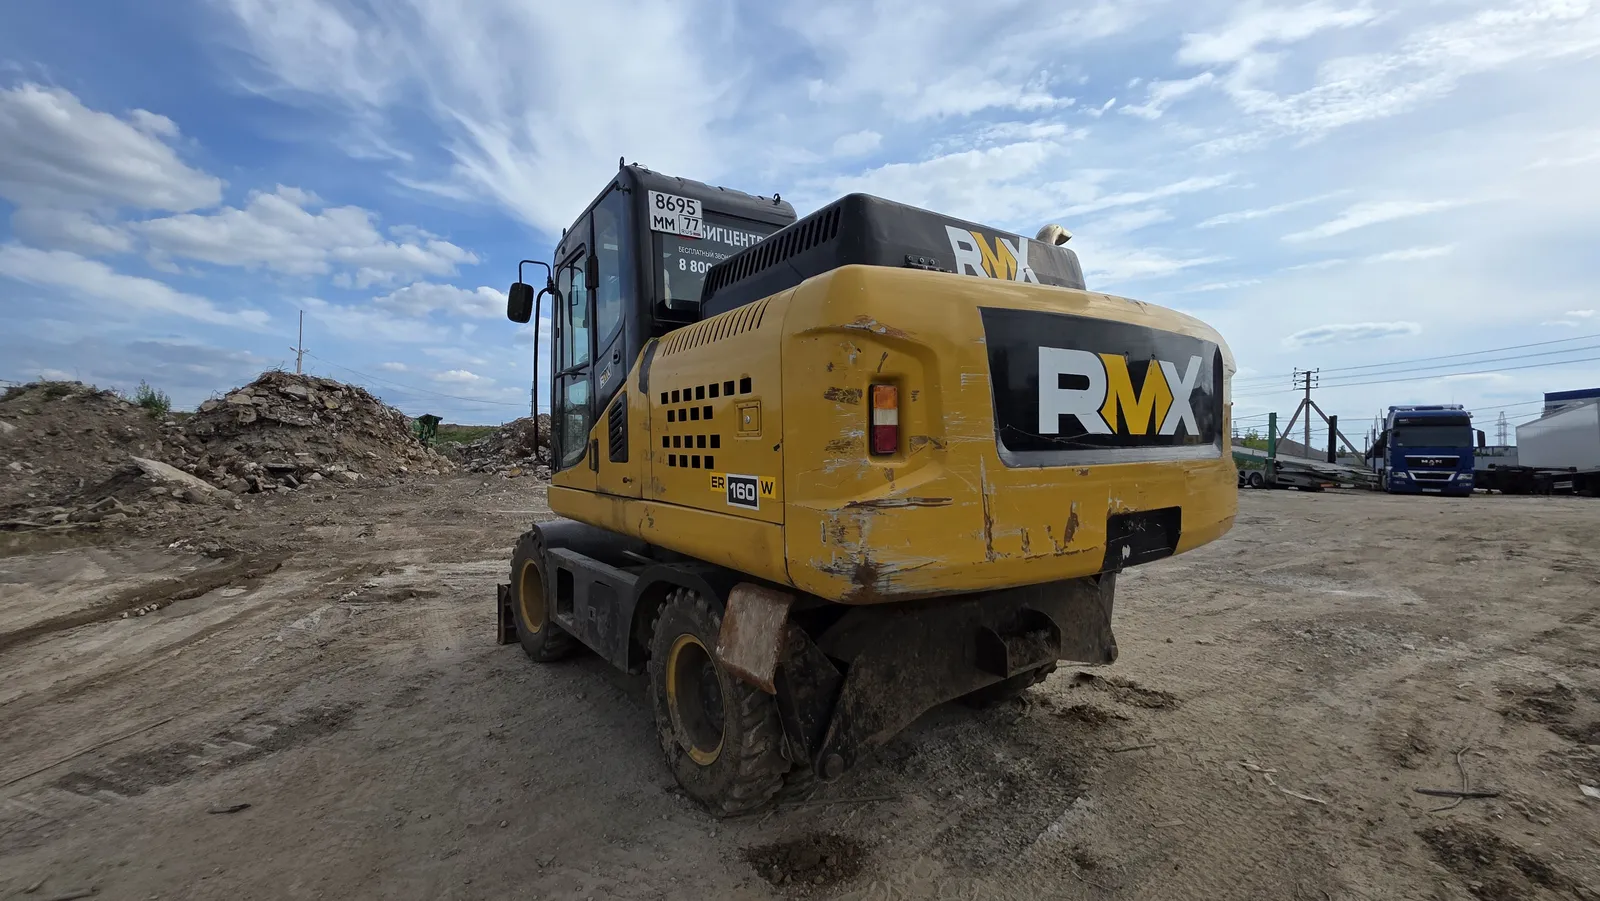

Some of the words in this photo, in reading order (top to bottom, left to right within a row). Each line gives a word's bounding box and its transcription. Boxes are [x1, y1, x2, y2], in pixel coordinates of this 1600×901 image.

[656, 194, 695, 215] 8695
[654, 215, 675, 230] ММ
[684, 217, 698, 230] 77
[678, 246, 714, 258] БЕСПЛАТНЫЙ
[945, 225, 1041, 284] RMX
[679, 258, 686, 271] 8
[1038, 346, 1203, 437] RMX
[711, 476, 725, 489] ER
[730, 482, 755, 501] 160
[760, 480, 774, 495] W
